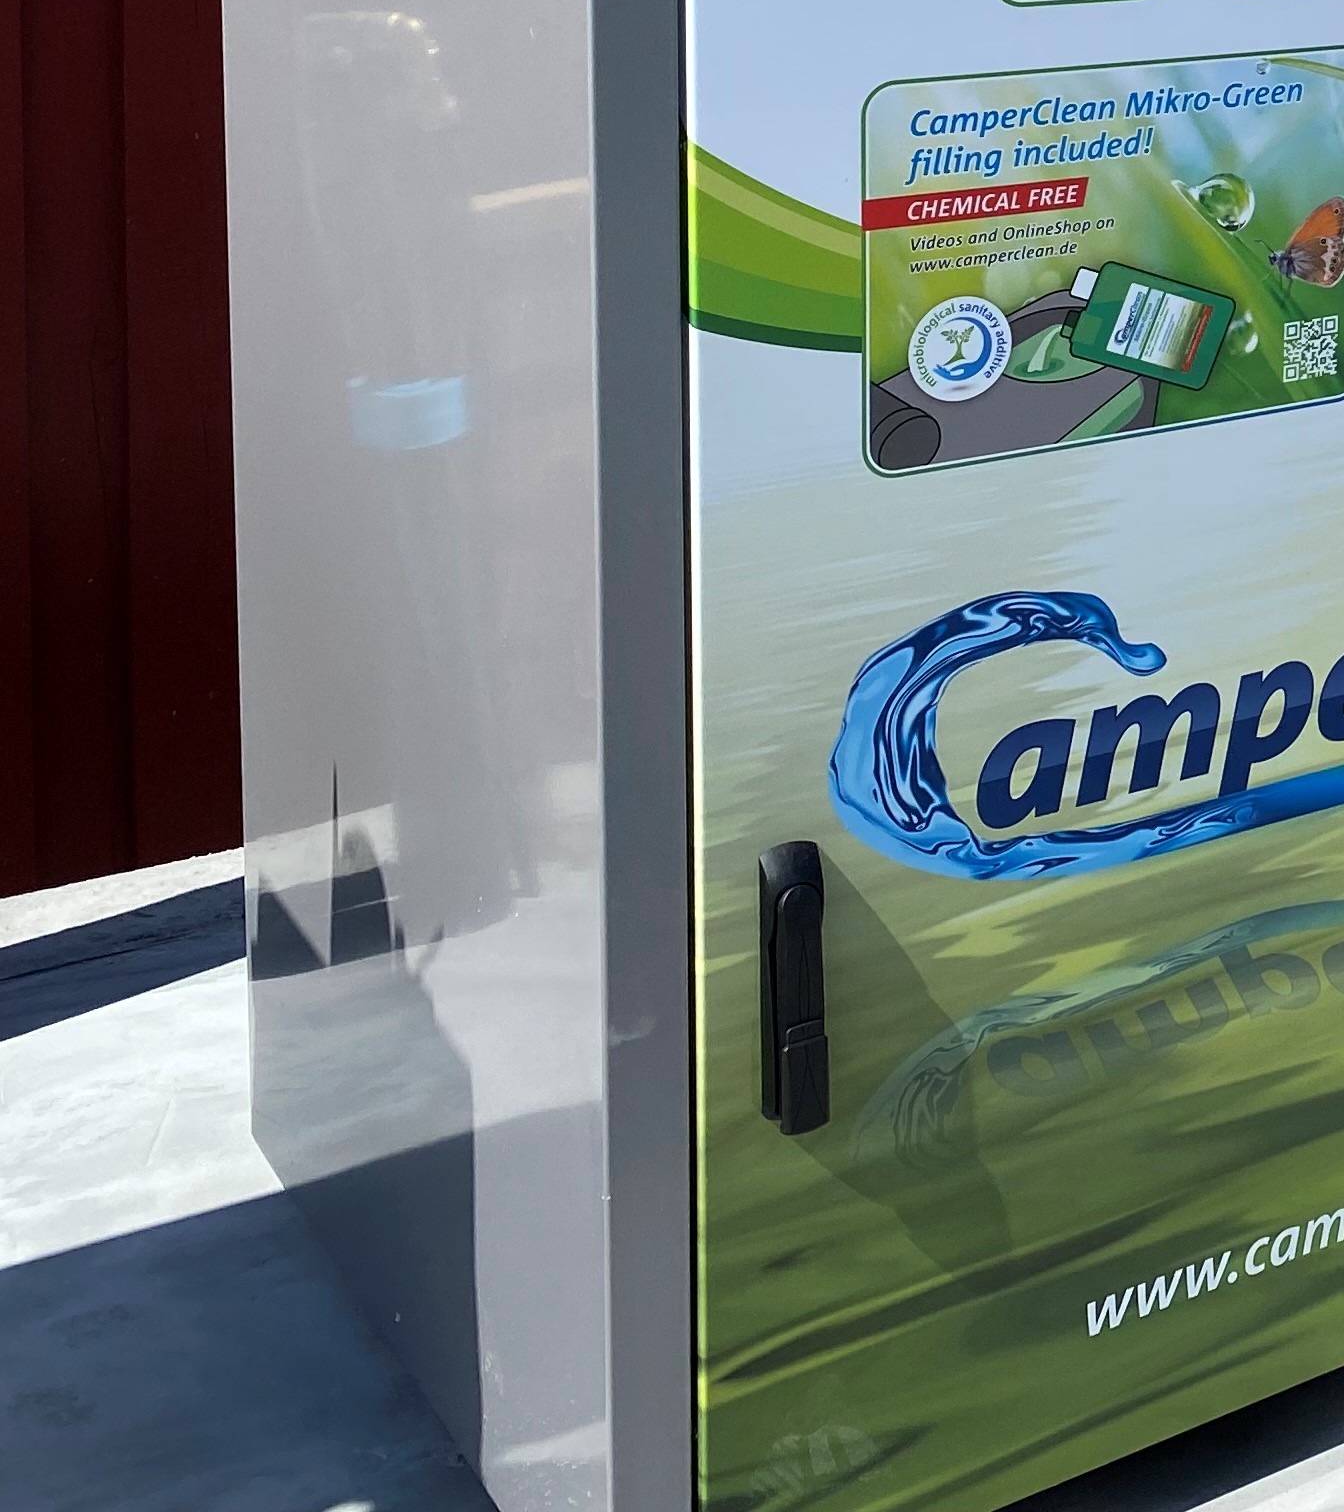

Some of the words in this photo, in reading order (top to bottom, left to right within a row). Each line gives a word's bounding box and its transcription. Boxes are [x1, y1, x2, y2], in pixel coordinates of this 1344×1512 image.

[909, 96, 1115, 138] CamperClean
[1124, 80, 1305, 119] Mikro-Green
[904, 145, 1003, 186] filling
[1012, 127, 1155, 169] included!
[906, 192, 1021, 221] CHEMICAL
[1026, 184, 1079, 207] FREE
[908, 241, 1079, 274] www.camperclean.de
[910, 232, 963, 252] Videos
[967, 227, 997, 245] and
[1003, 217, 1092, 244] OnlineShop
[1096, 218, 1116, 231] on
[912, 303, 957, 388] microbiological
[958, 302, 1001, 331] sanitary
[983, 327, 1008, 380] additive
